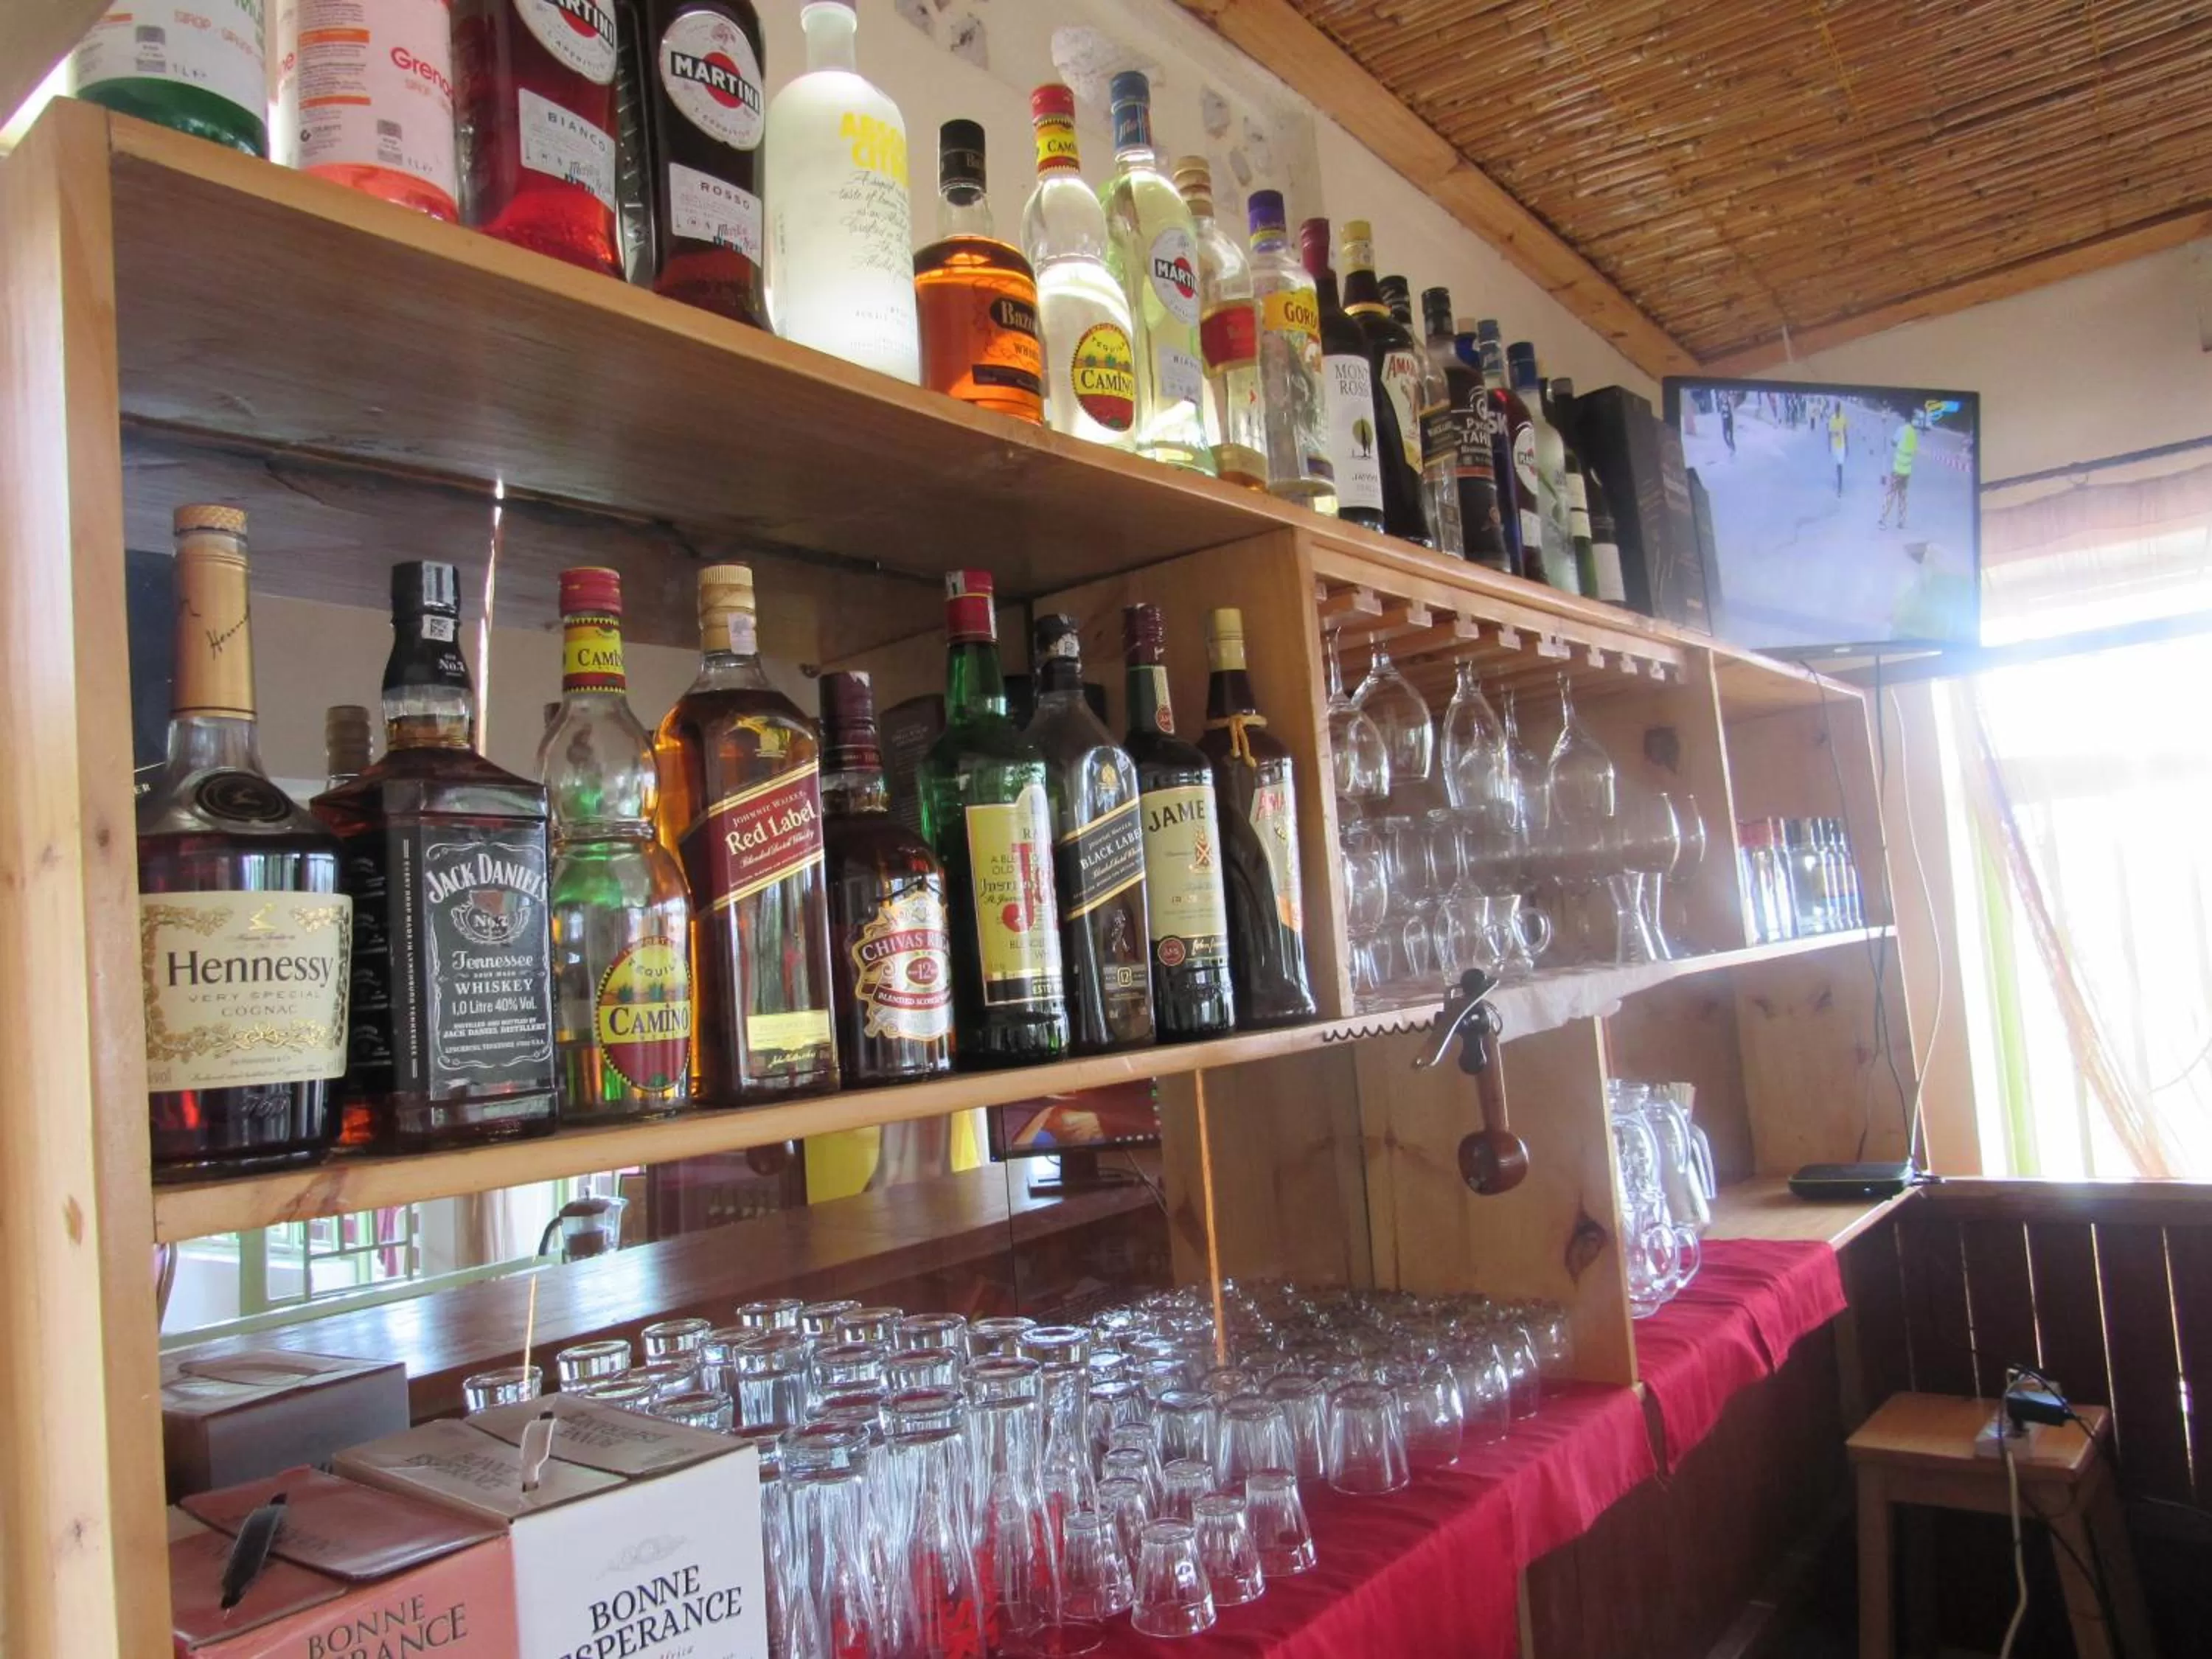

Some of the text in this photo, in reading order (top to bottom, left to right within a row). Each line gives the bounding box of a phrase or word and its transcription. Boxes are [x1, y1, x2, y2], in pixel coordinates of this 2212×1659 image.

[674, 55, 760, 112] MARTINI
[548, 112, 606, 153] BIANCO
[700, 181, 751, 210] ROSSO
[725, 799, 816, 855] Red Label
[1080, 843, 1114, 870] BLACK
[425, 861, 477, 904] JACK
[451, 950, 533, 970] Tennessee
[861, 931, 923, 961] CHIVAS
[167, 950, 334, 989] Hennessy
[917, 961, 931, 980] 12
[189, 990, 320, 1004] VERY SPECIAL
[455, 978, 534, 995] WHISKEY
[220, 1004, 298, 1018] COGNAC
[470, 998, 493, 1014] Litre
[495, 998, 518, 1012] 40%
[588, 1564, 701, 1636] BONNE
[308, 1593, 426, 1659] BONNE
[559, 1586, 742, 1659] SPERANCE
